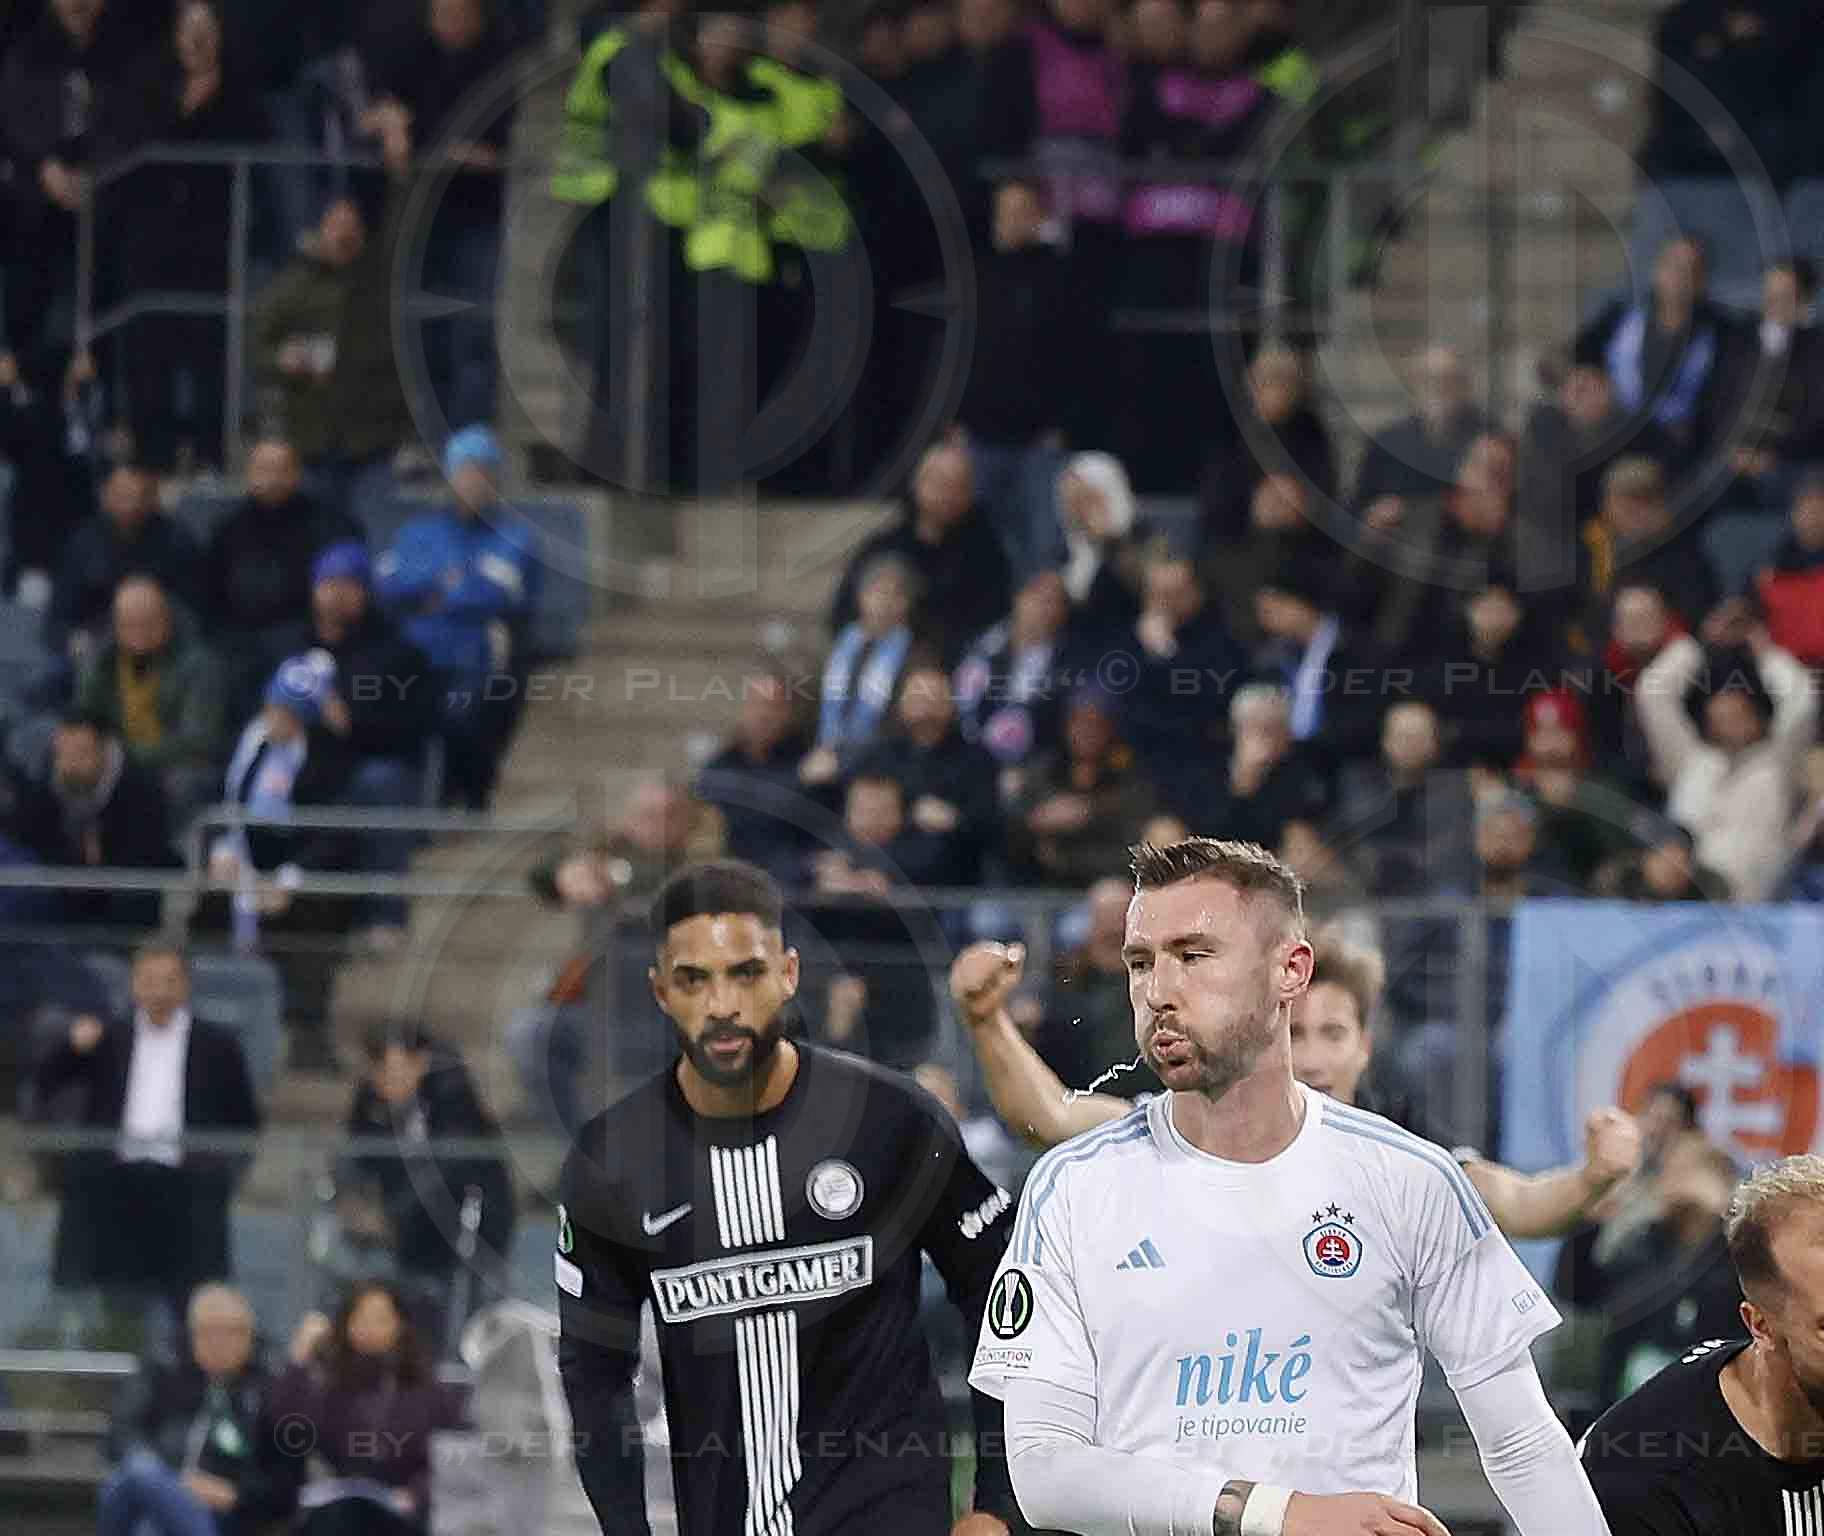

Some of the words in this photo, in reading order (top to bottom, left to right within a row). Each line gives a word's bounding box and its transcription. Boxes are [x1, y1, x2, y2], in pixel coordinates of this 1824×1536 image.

[665, 1248, 860, 1314] PUNTIGAMER
[1175, 1327, 1312, 1407] niké
[1175, 1414, 1199, 1441] je
[1202, 1413, 1307, 1440] tipovanie
